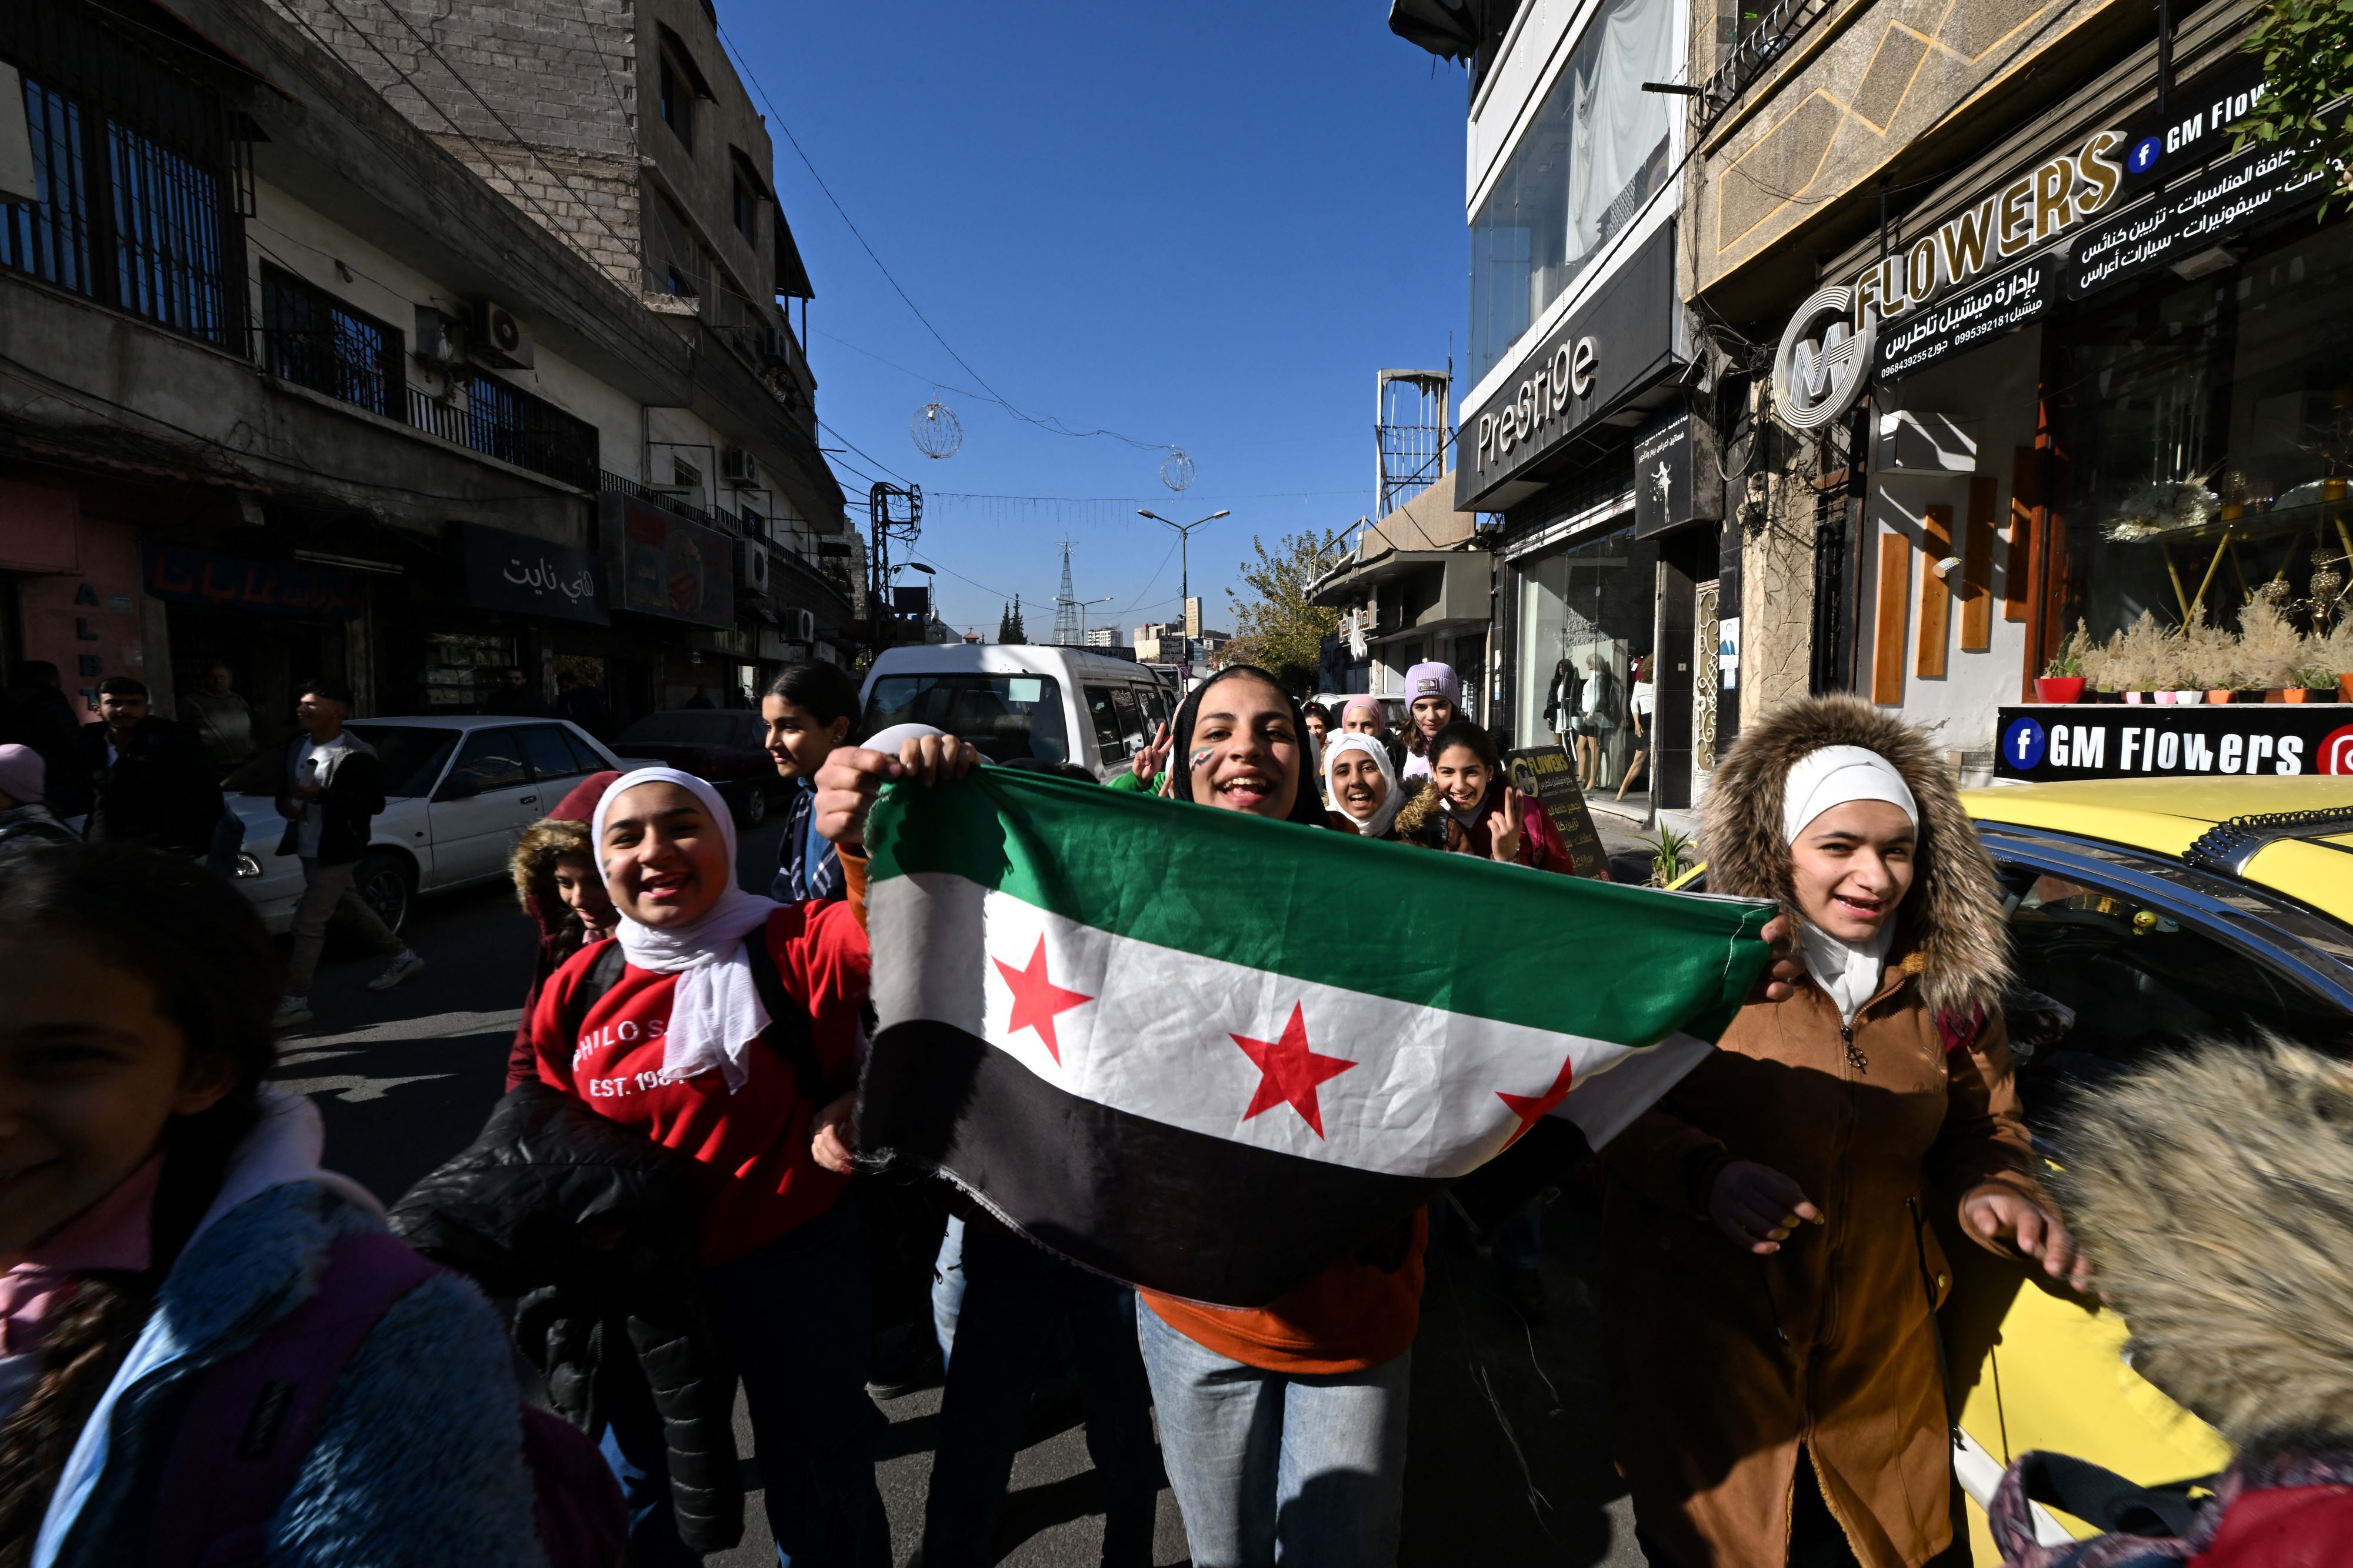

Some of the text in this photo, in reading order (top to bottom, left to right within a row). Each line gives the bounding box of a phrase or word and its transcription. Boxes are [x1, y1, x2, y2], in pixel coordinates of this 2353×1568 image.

[2167, 112, 2202, 154] GM
[2177, 165, 2253, 214] المناسبات
[1854, 130, 2124, 335] FLOWERS
[2129, 207, 2167, 241] تزيين
[2183, 189, 2272, 238] سيفونيرات
[2081, 228, 2127, 263] كنائس
[2121, 235, 2171, 266] سيارات
[2081, 249, 2120, 288] أعراس
[1885, 268, 2040, 359] بإدارة ميشيل تاطرس
[1954, 312, 2009, 346] 0995392181
[2009, 299, 2042, 322] ميشيل
[1881, 352, 1927, 378] 0968439255
[1478, 336, 1596, 473] Prestige
[1634, 407, 1688, 449] Elegance Land
[1669, 430, 1684, 446] فساتين
[503, 557, 556, 596] نايت
[1527, 753, 1569, 776] FLOWERS
[2049, 724, 2105, 769] GM
[2120, 726, 2304, 775] Flowers
[589, 1070, 685, 1097] EST. 198
